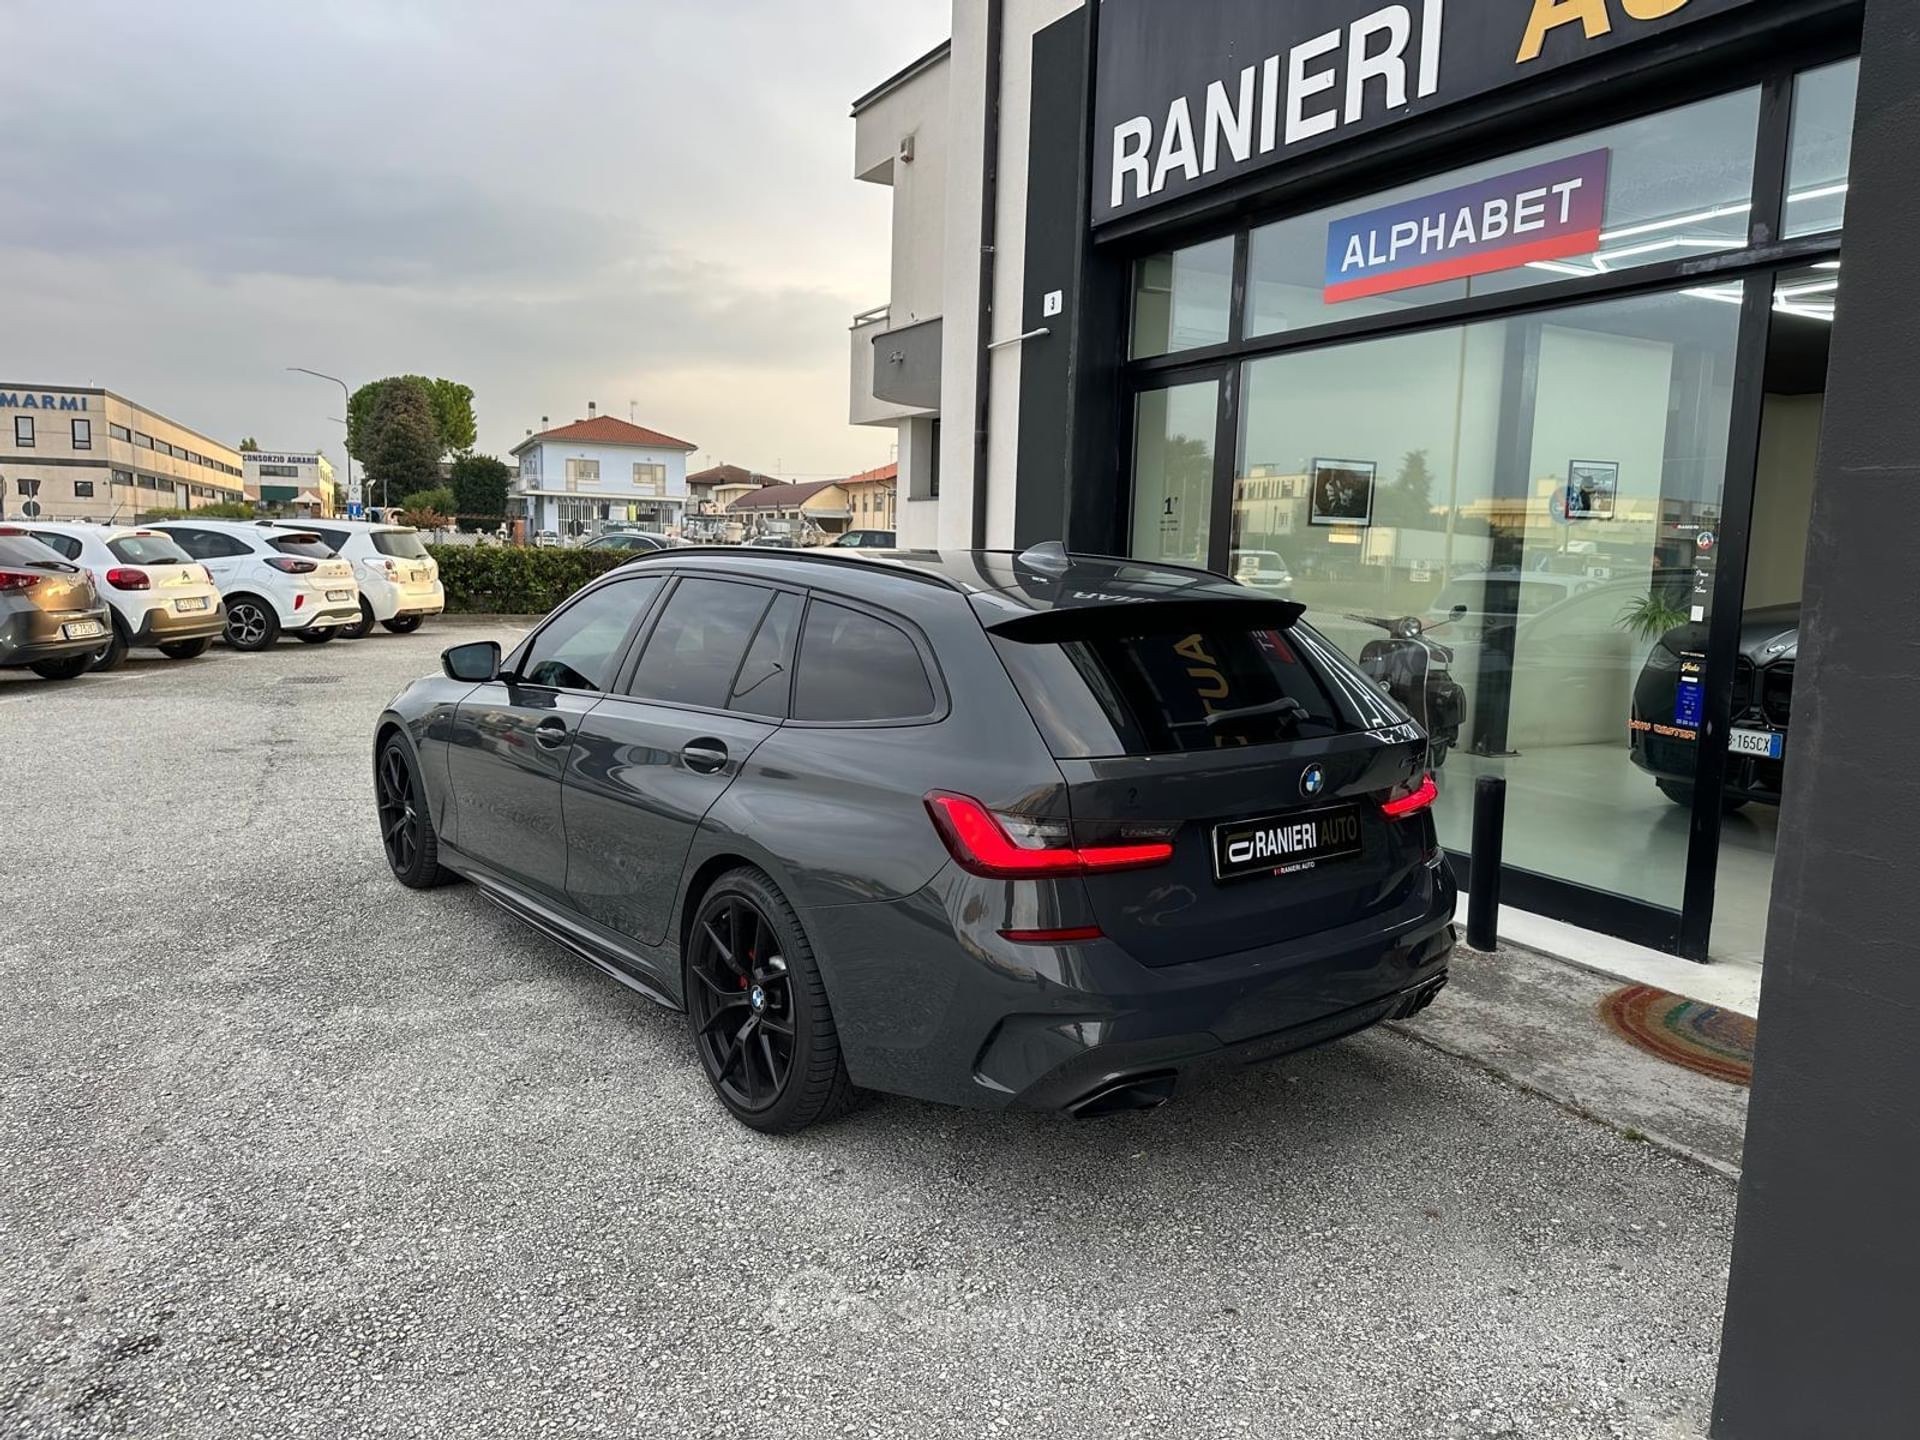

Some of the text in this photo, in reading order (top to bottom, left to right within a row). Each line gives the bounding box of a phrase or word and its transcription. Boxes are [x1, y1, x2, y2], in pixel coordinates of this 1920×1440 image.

[1111, 0, 1444, 208] RANIERI
[1341, 178, 1583, 272] ALPHABET
[0, 393, 87, 411] MARMI
[242, 454, 319, 465] CONSORZIO AGRARIO
[1255, 816, 1357, 858] RANIERI AUTO
